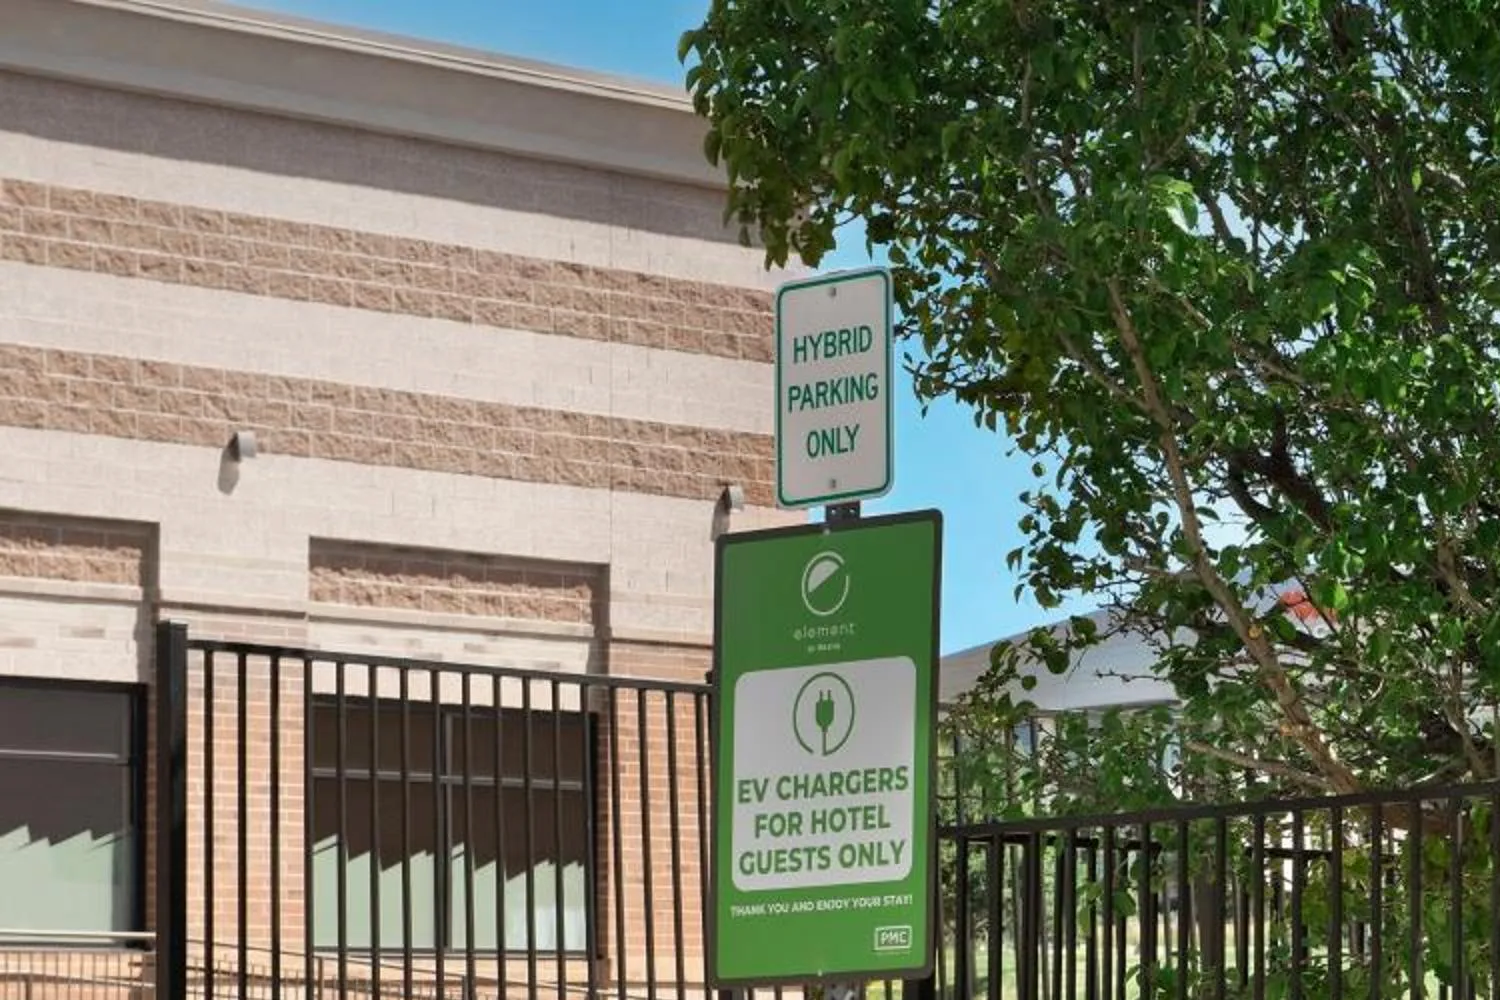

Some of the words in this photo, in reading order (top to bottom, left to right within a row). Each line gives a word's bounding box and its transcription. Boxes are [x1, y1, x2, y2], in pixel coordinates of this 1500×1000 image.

[793, 325, 873, 364] HYBRID
[788, 373, 879, 413] PARKING
[807, 424, 860, 458] ONLY
[793, 623, 855, 640] element
[737, 778, 769, 803] EV
[776, 766, 909, 801] CHARGERS
[755, 811, 802, 838] FOR
[811, 804, 890, 834] HOTEL
[739, 846, 831, 875] GUESTS
[838, 840, 905, 869] ONLY
[730, 903, 766, 918] THANK
[768, 902, 788, 916] YOU
[791, 900, 815, 913] AND
[816, 898, 850, 911] ENJOY
[852, 896, 881, 908] YOUR
[883, 894, 913, 906] STAY!
[881, 931, 907, 946] PMC
